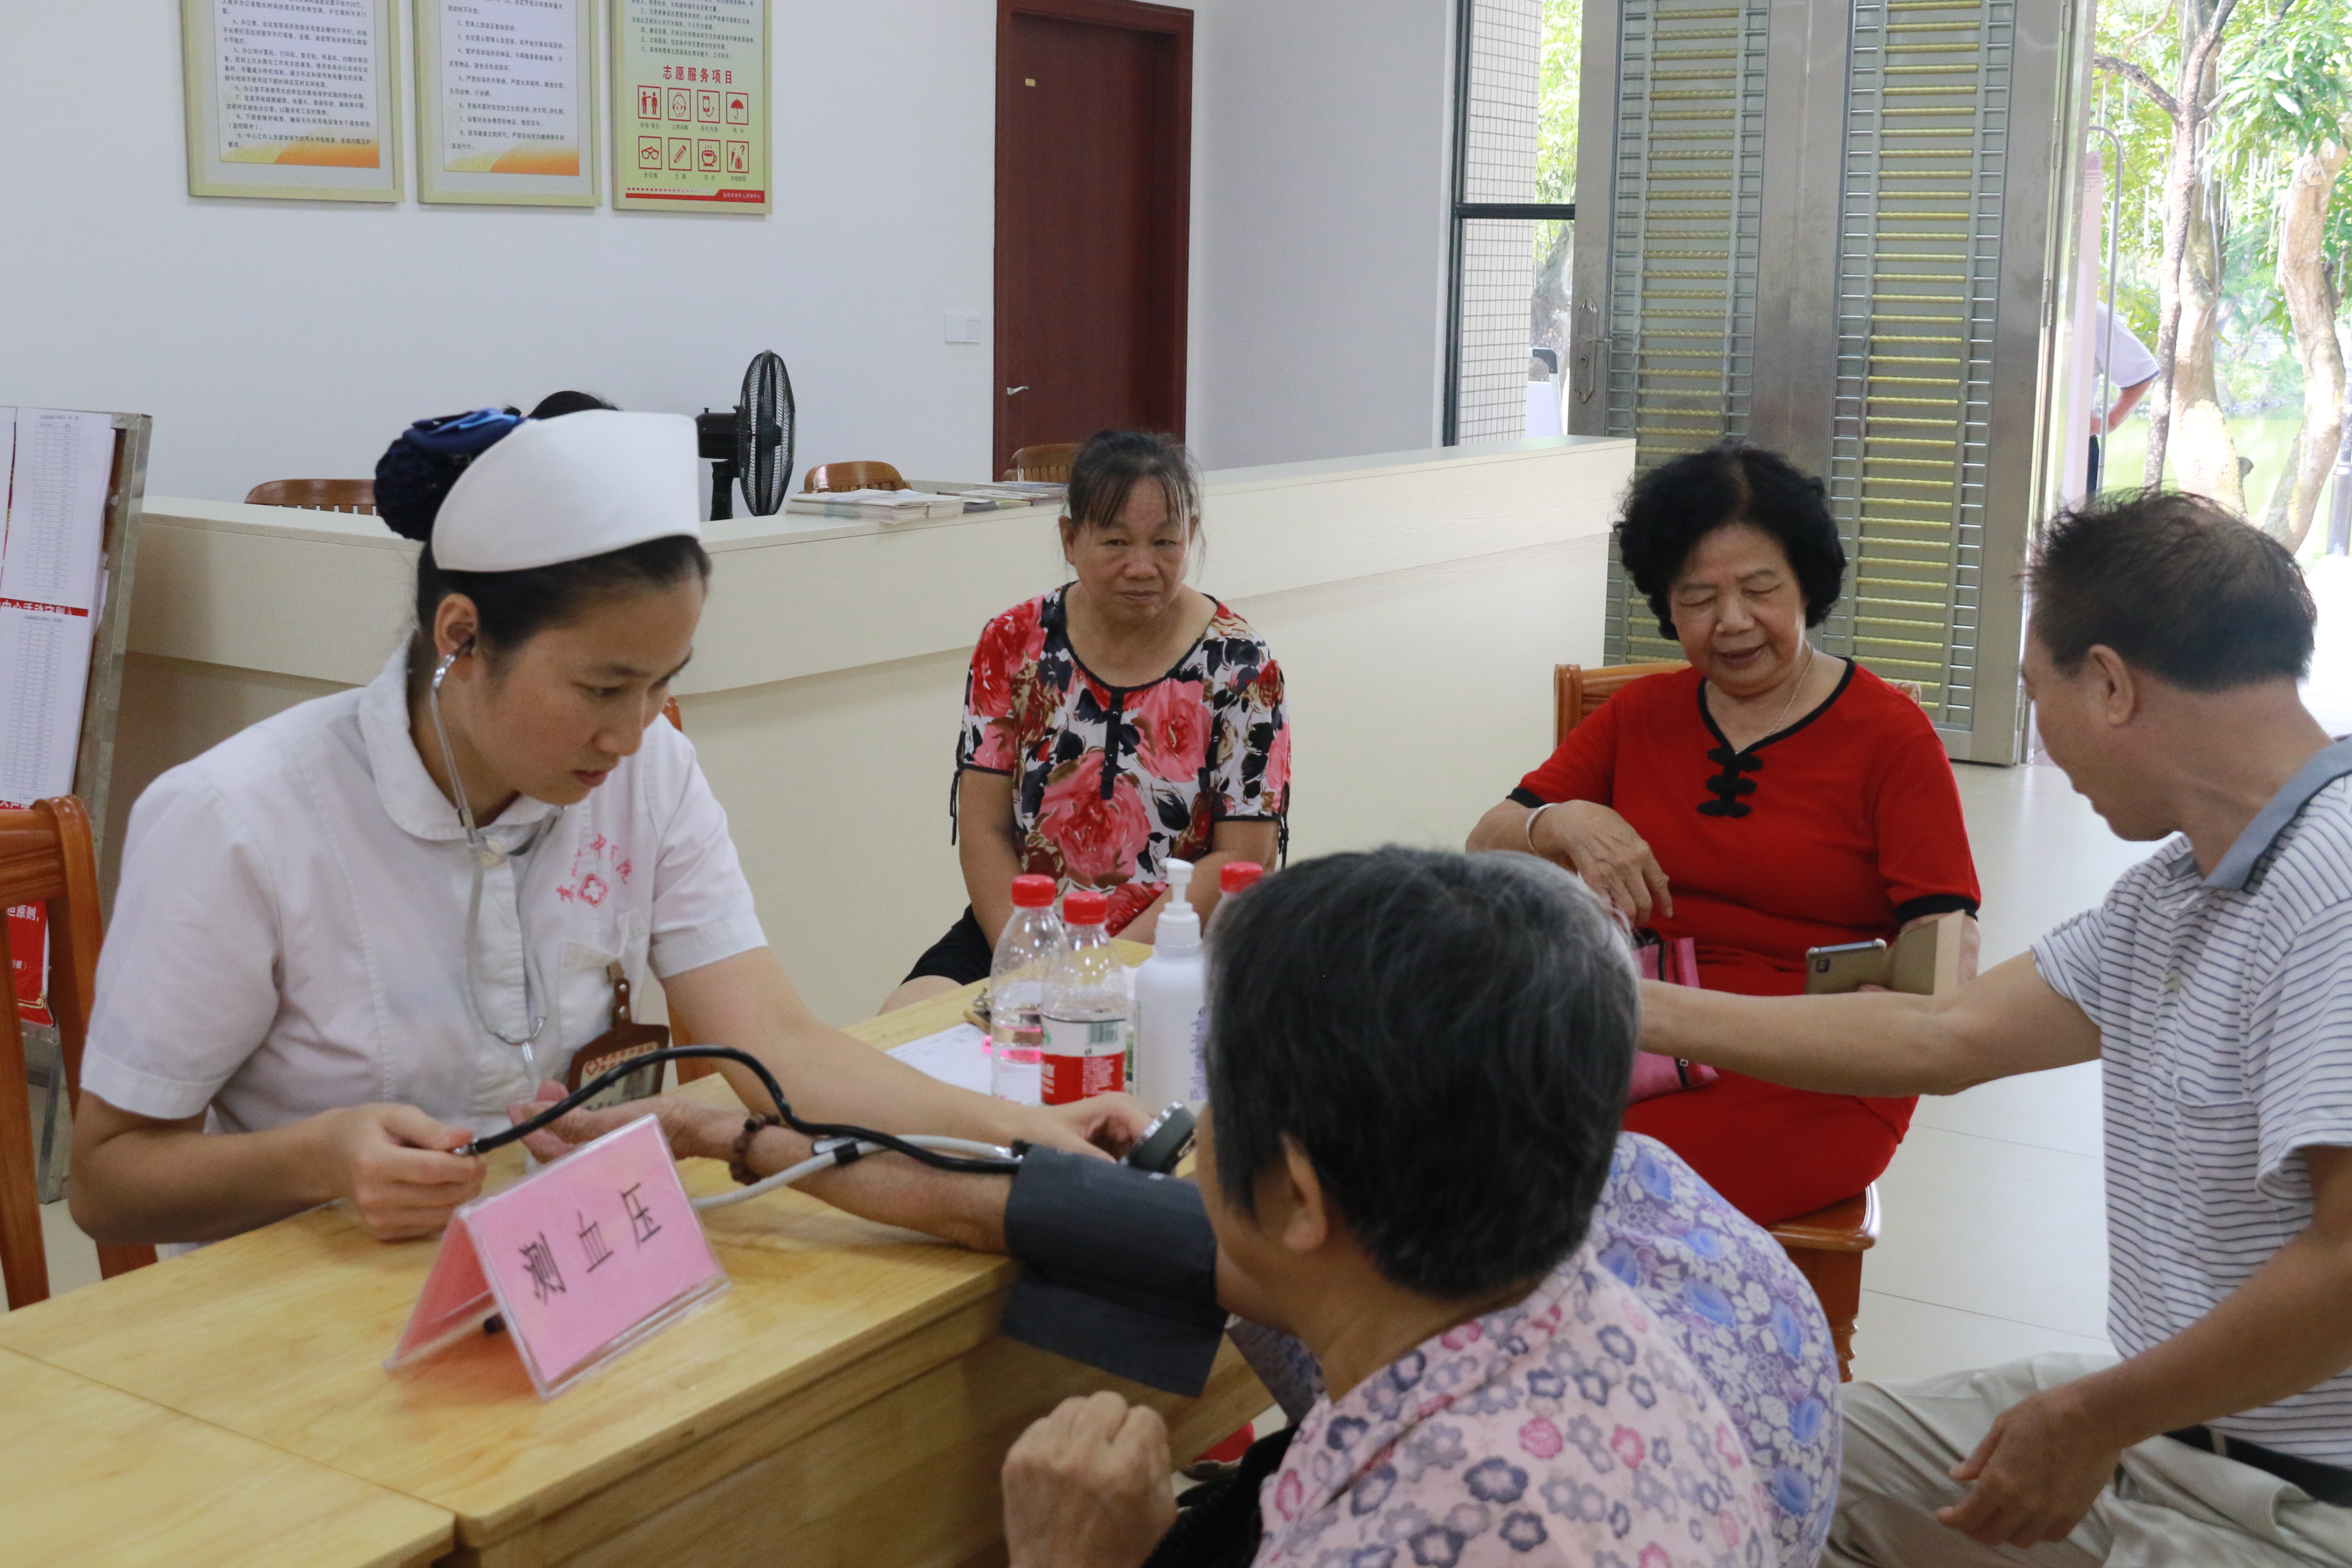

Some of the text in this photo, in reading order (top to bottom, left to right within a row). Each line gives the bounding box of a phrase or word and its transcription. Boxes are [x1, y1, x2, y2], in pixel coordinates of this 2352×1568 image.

[663, 65, 732, 84] 志愿服务项目
[518, 1182, 662, 1304] 测血压
